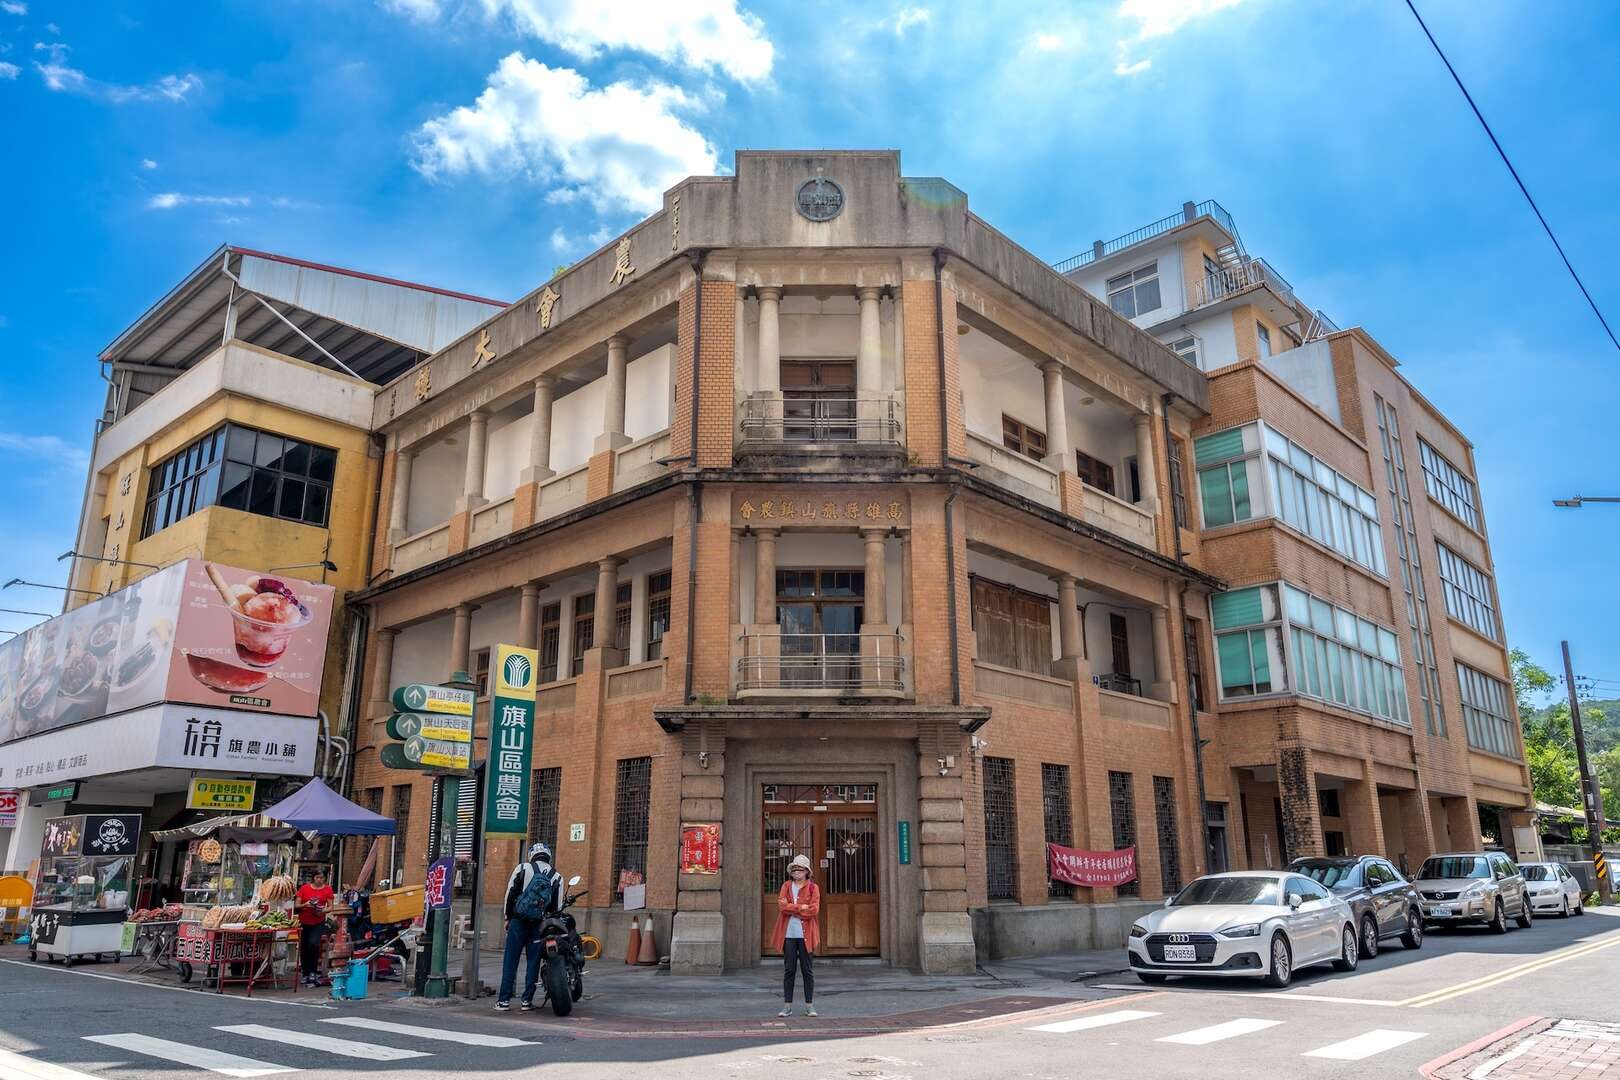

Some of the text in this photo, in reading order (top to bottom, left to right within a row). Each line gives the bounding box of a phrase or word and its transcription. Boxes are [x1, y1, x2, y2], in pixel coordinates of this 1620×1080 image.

[496, 704, 527, 820] 旗山區農會
[574, 831, 581, 839] 67
